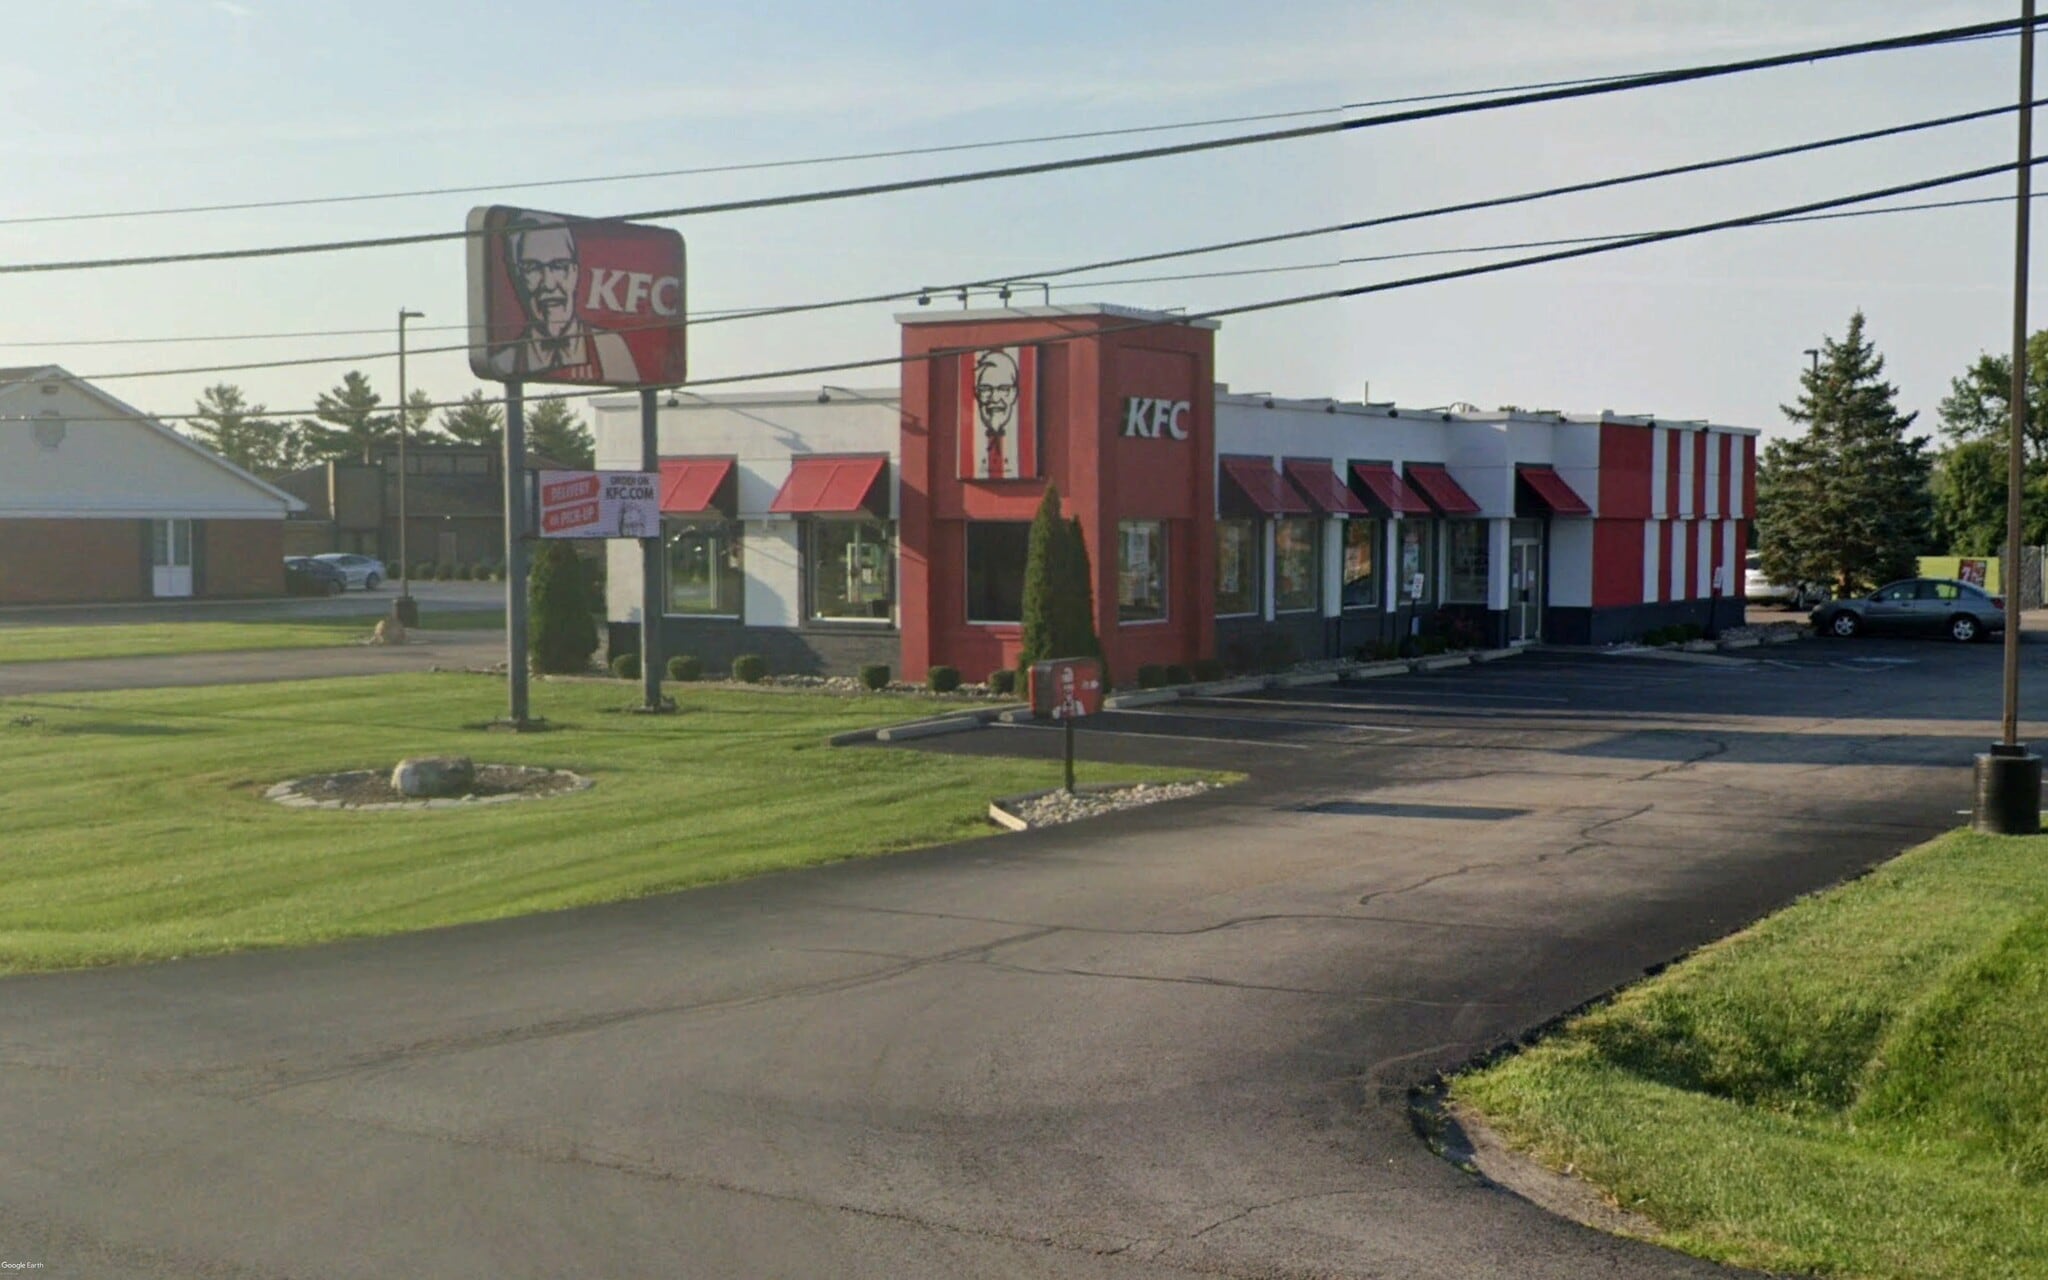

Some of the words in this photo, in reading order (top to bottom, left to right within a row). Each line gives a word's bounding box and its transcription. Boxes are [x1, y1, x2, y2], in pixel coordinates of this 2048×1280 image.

[585, 267, 680, 316] KFC
[1124, 396, 1191, 441] KFC
[551, 481, 591, 501] DELIVERY
[610, 476, 636, 486] ORDER
[637, 477, 649, 486] ON
[606, 488, 654, 500] KFC.COM
[560, 506, 595, 527] PICK-UP
